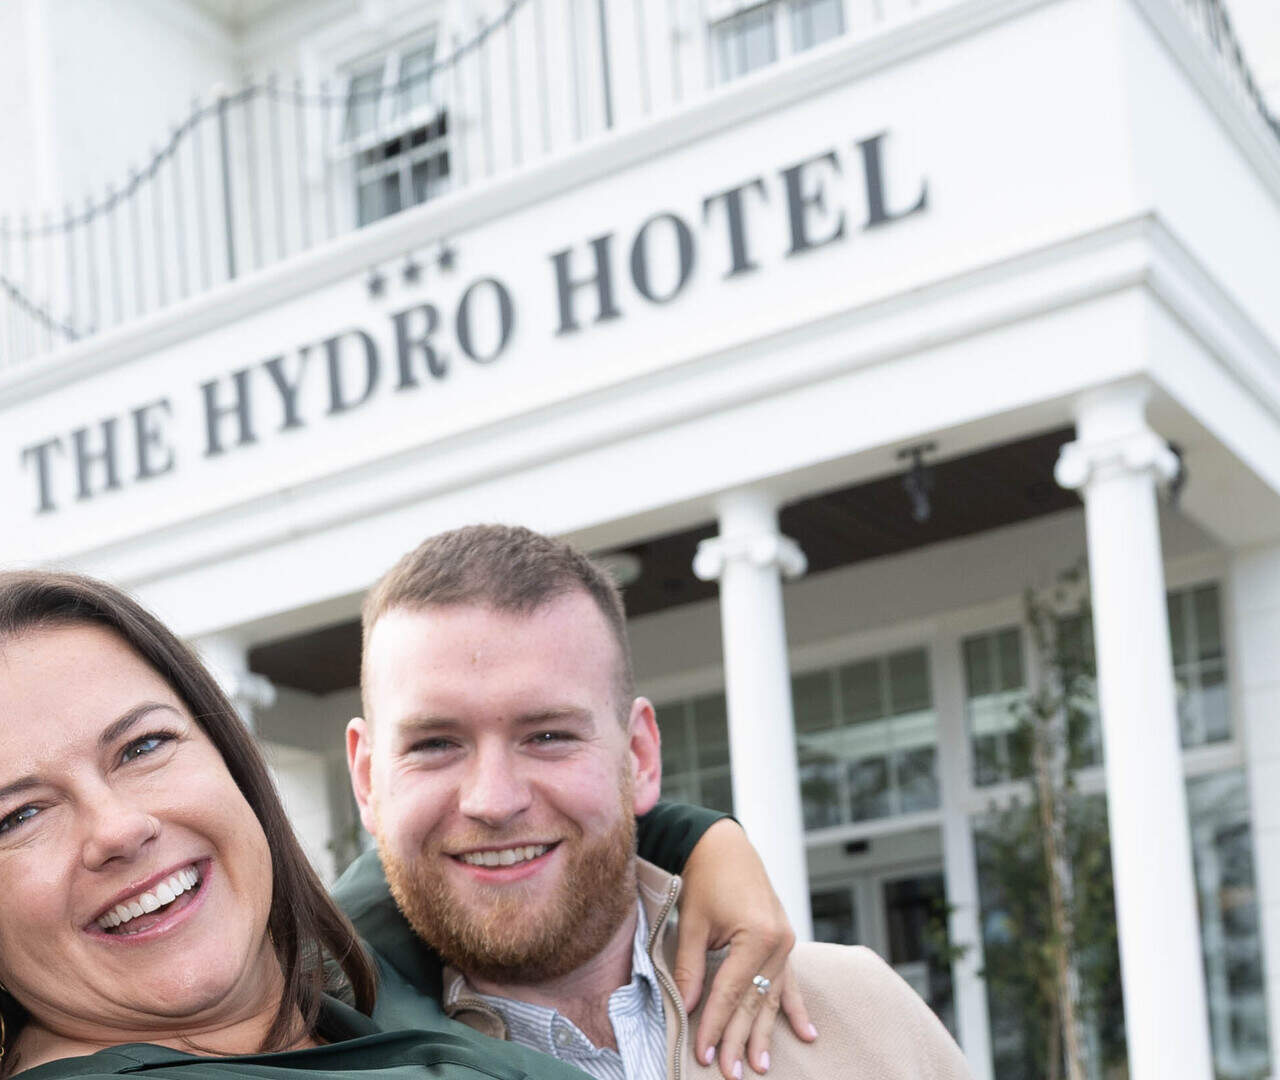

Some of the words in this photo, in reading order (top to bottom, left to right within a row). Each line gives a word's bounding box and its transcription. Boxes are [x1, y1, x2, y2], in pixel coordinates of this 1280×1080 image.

[20, 397, 176, 513] THE
[199, 275, 517, 458] HYDRO
[548, 130, 930, 337] HOTEL
